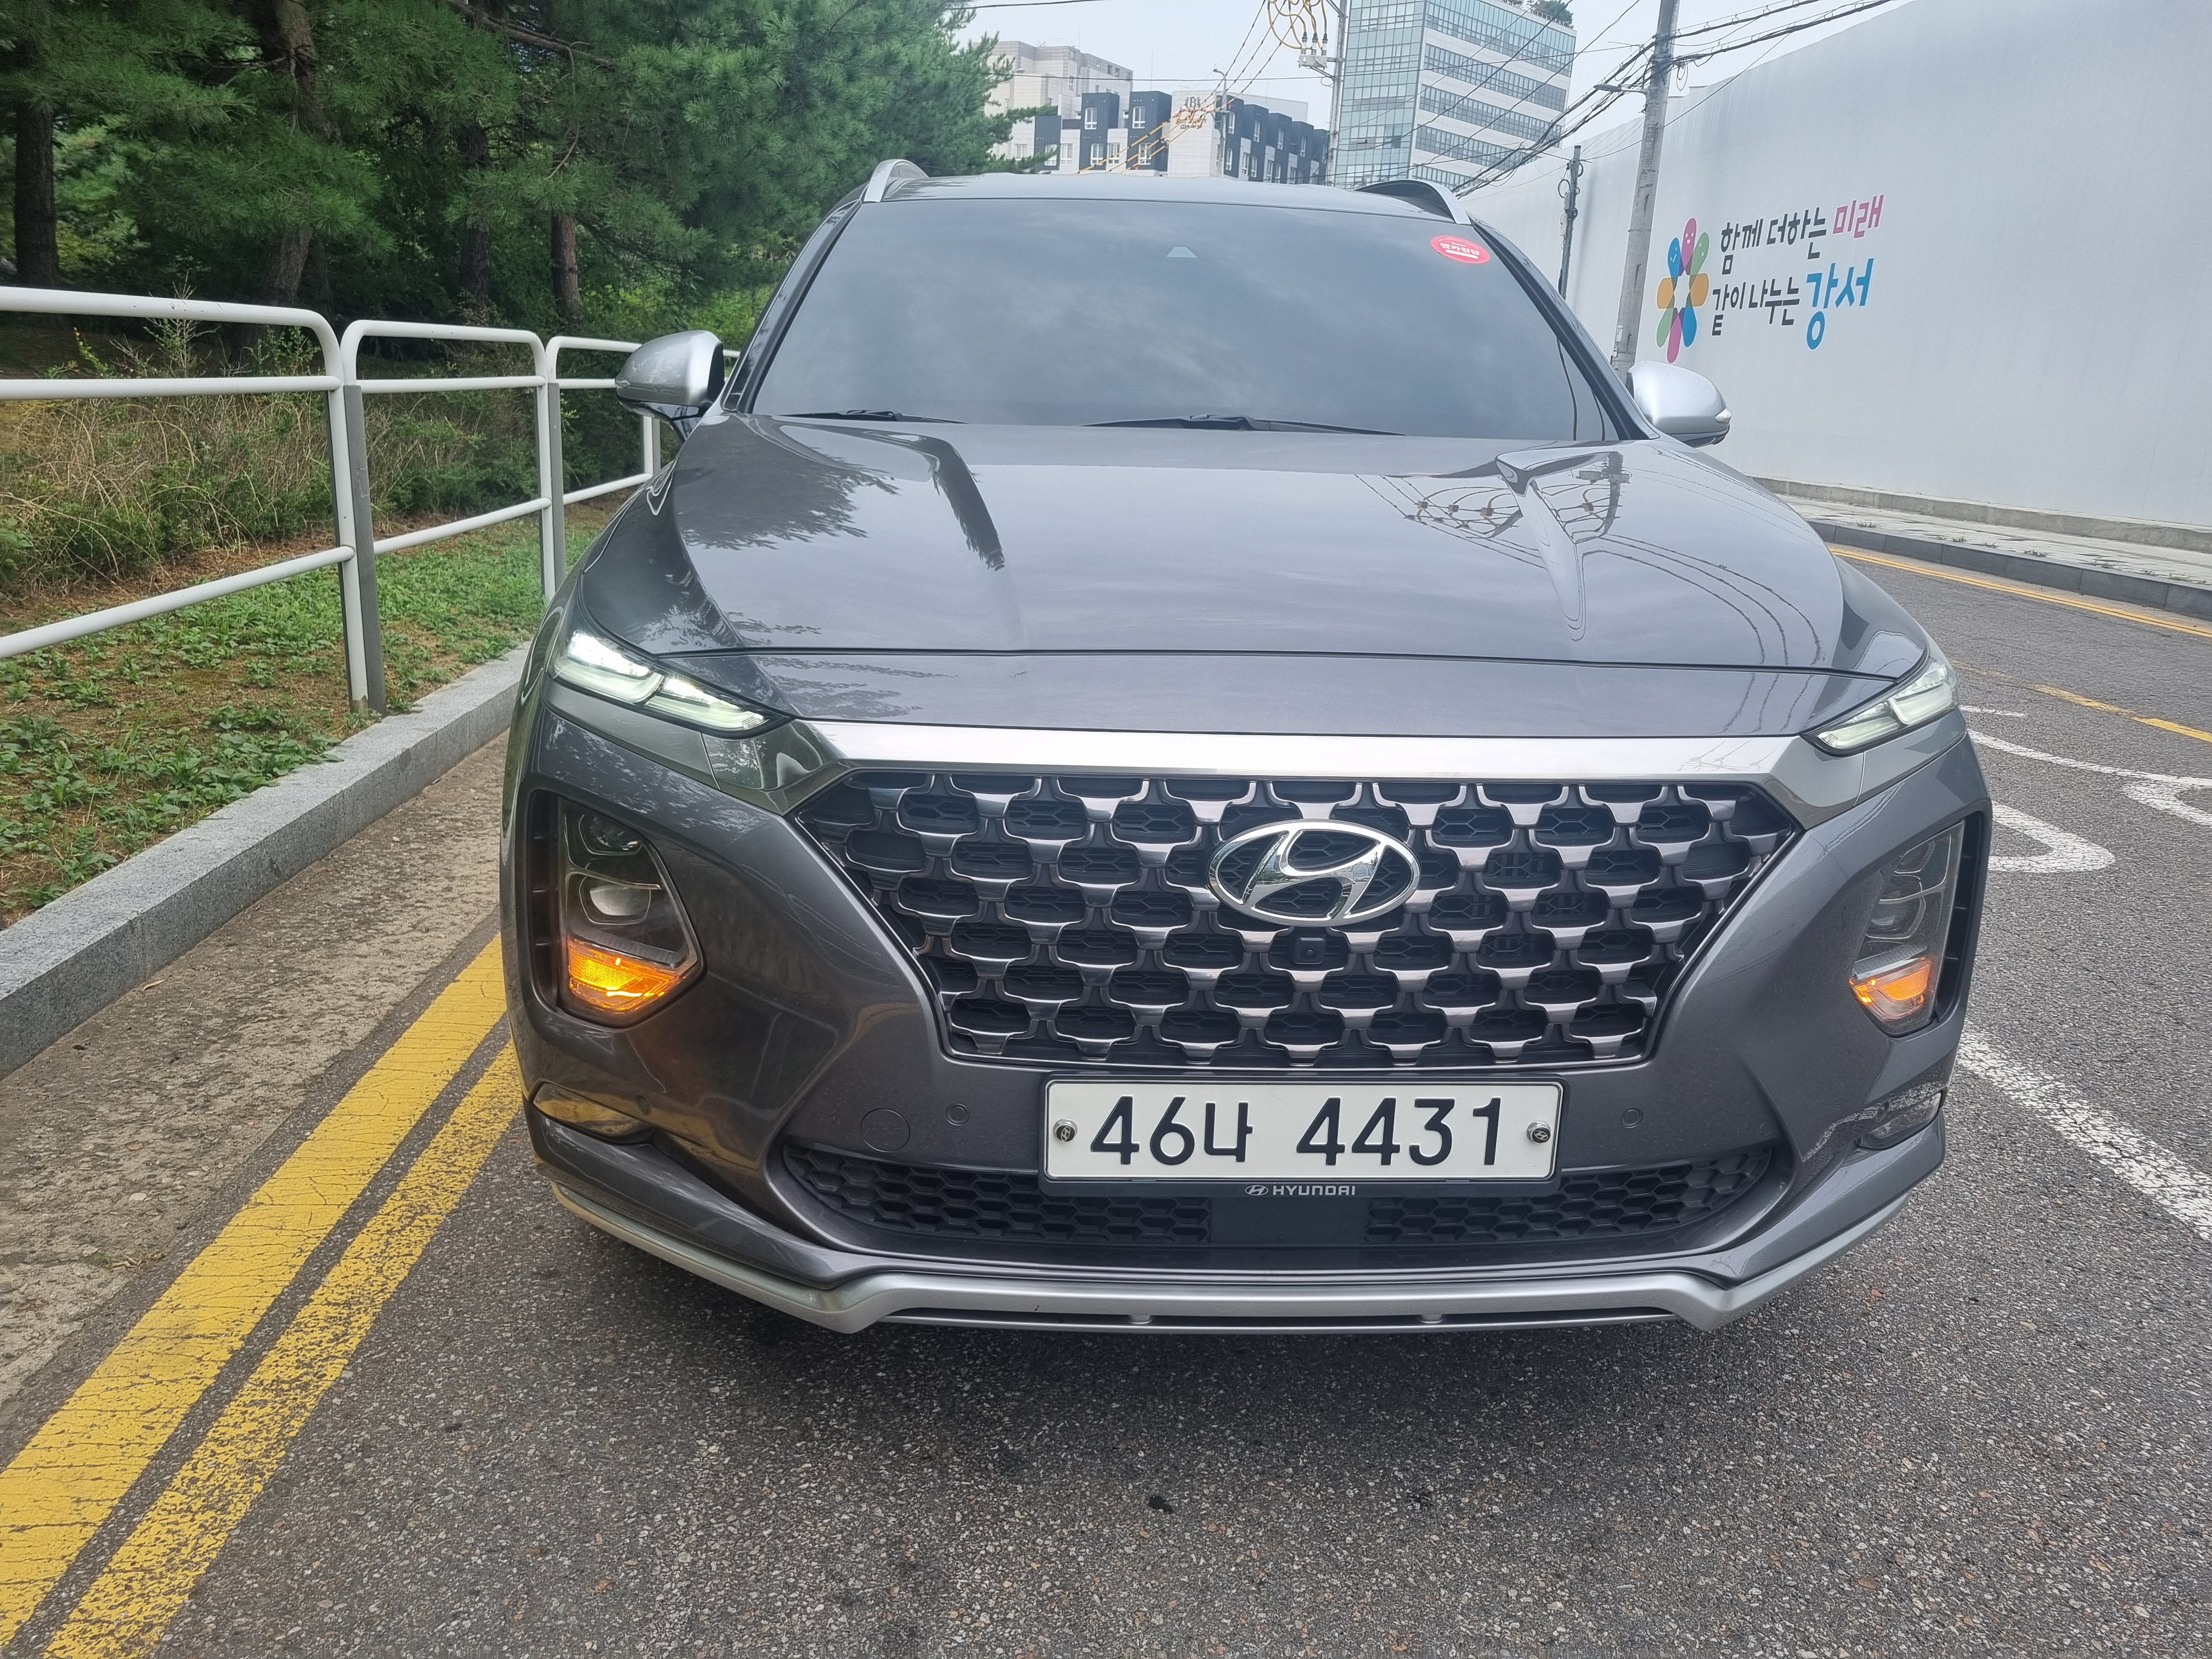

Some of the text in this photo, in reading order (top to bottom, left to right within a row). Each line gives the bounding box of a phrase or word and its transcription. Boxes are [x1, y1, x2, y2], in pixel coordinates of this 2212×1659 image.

[1720, 195, 1884, 275] 함께 더하는 미래
[1712, 258, 1874, 350] 같이 나누는 강서
[1090, 1094, 1502, 1166] 46나 4431
[1272, 1185, 1356, 1196] HYUNDAI
